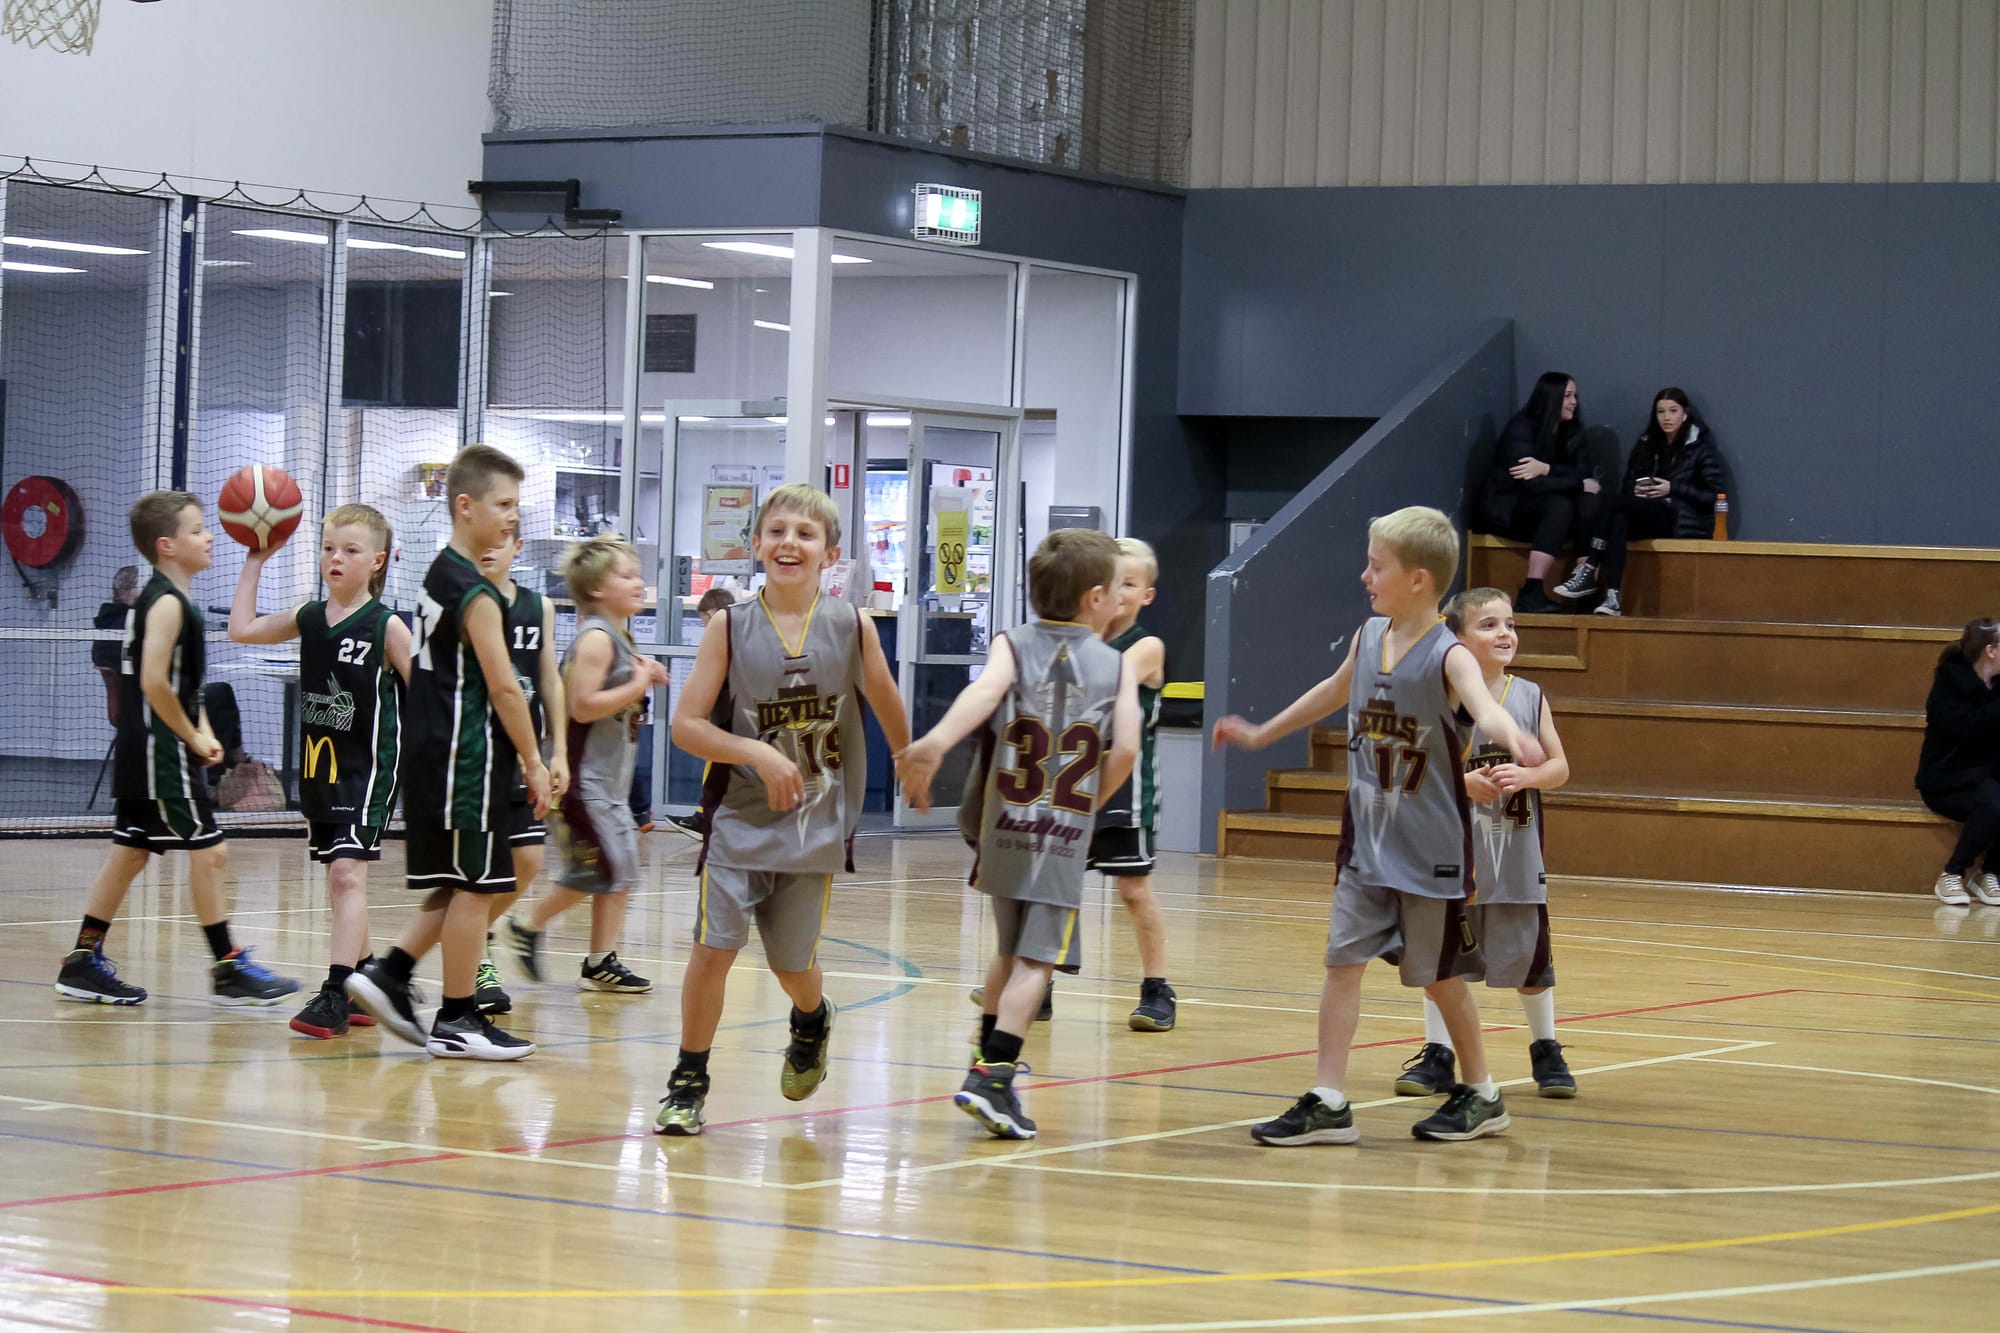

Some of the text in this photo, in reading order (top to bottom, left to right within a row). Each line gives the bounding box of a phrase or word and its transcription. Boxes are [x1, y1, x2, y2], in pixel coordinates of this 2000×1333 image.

[679, 557, 687, 595] PULL
[337, 637, 372, 666] 27
[513, 626, 540, 650] 17
[756, 693, 839, 735] DEVILS
[798, 720, 842, 775] 19
[996, 714, 1102, 816] 32
[1374, 744, 1429, 794] 17
[1503, 786, 1534, 830] 4
